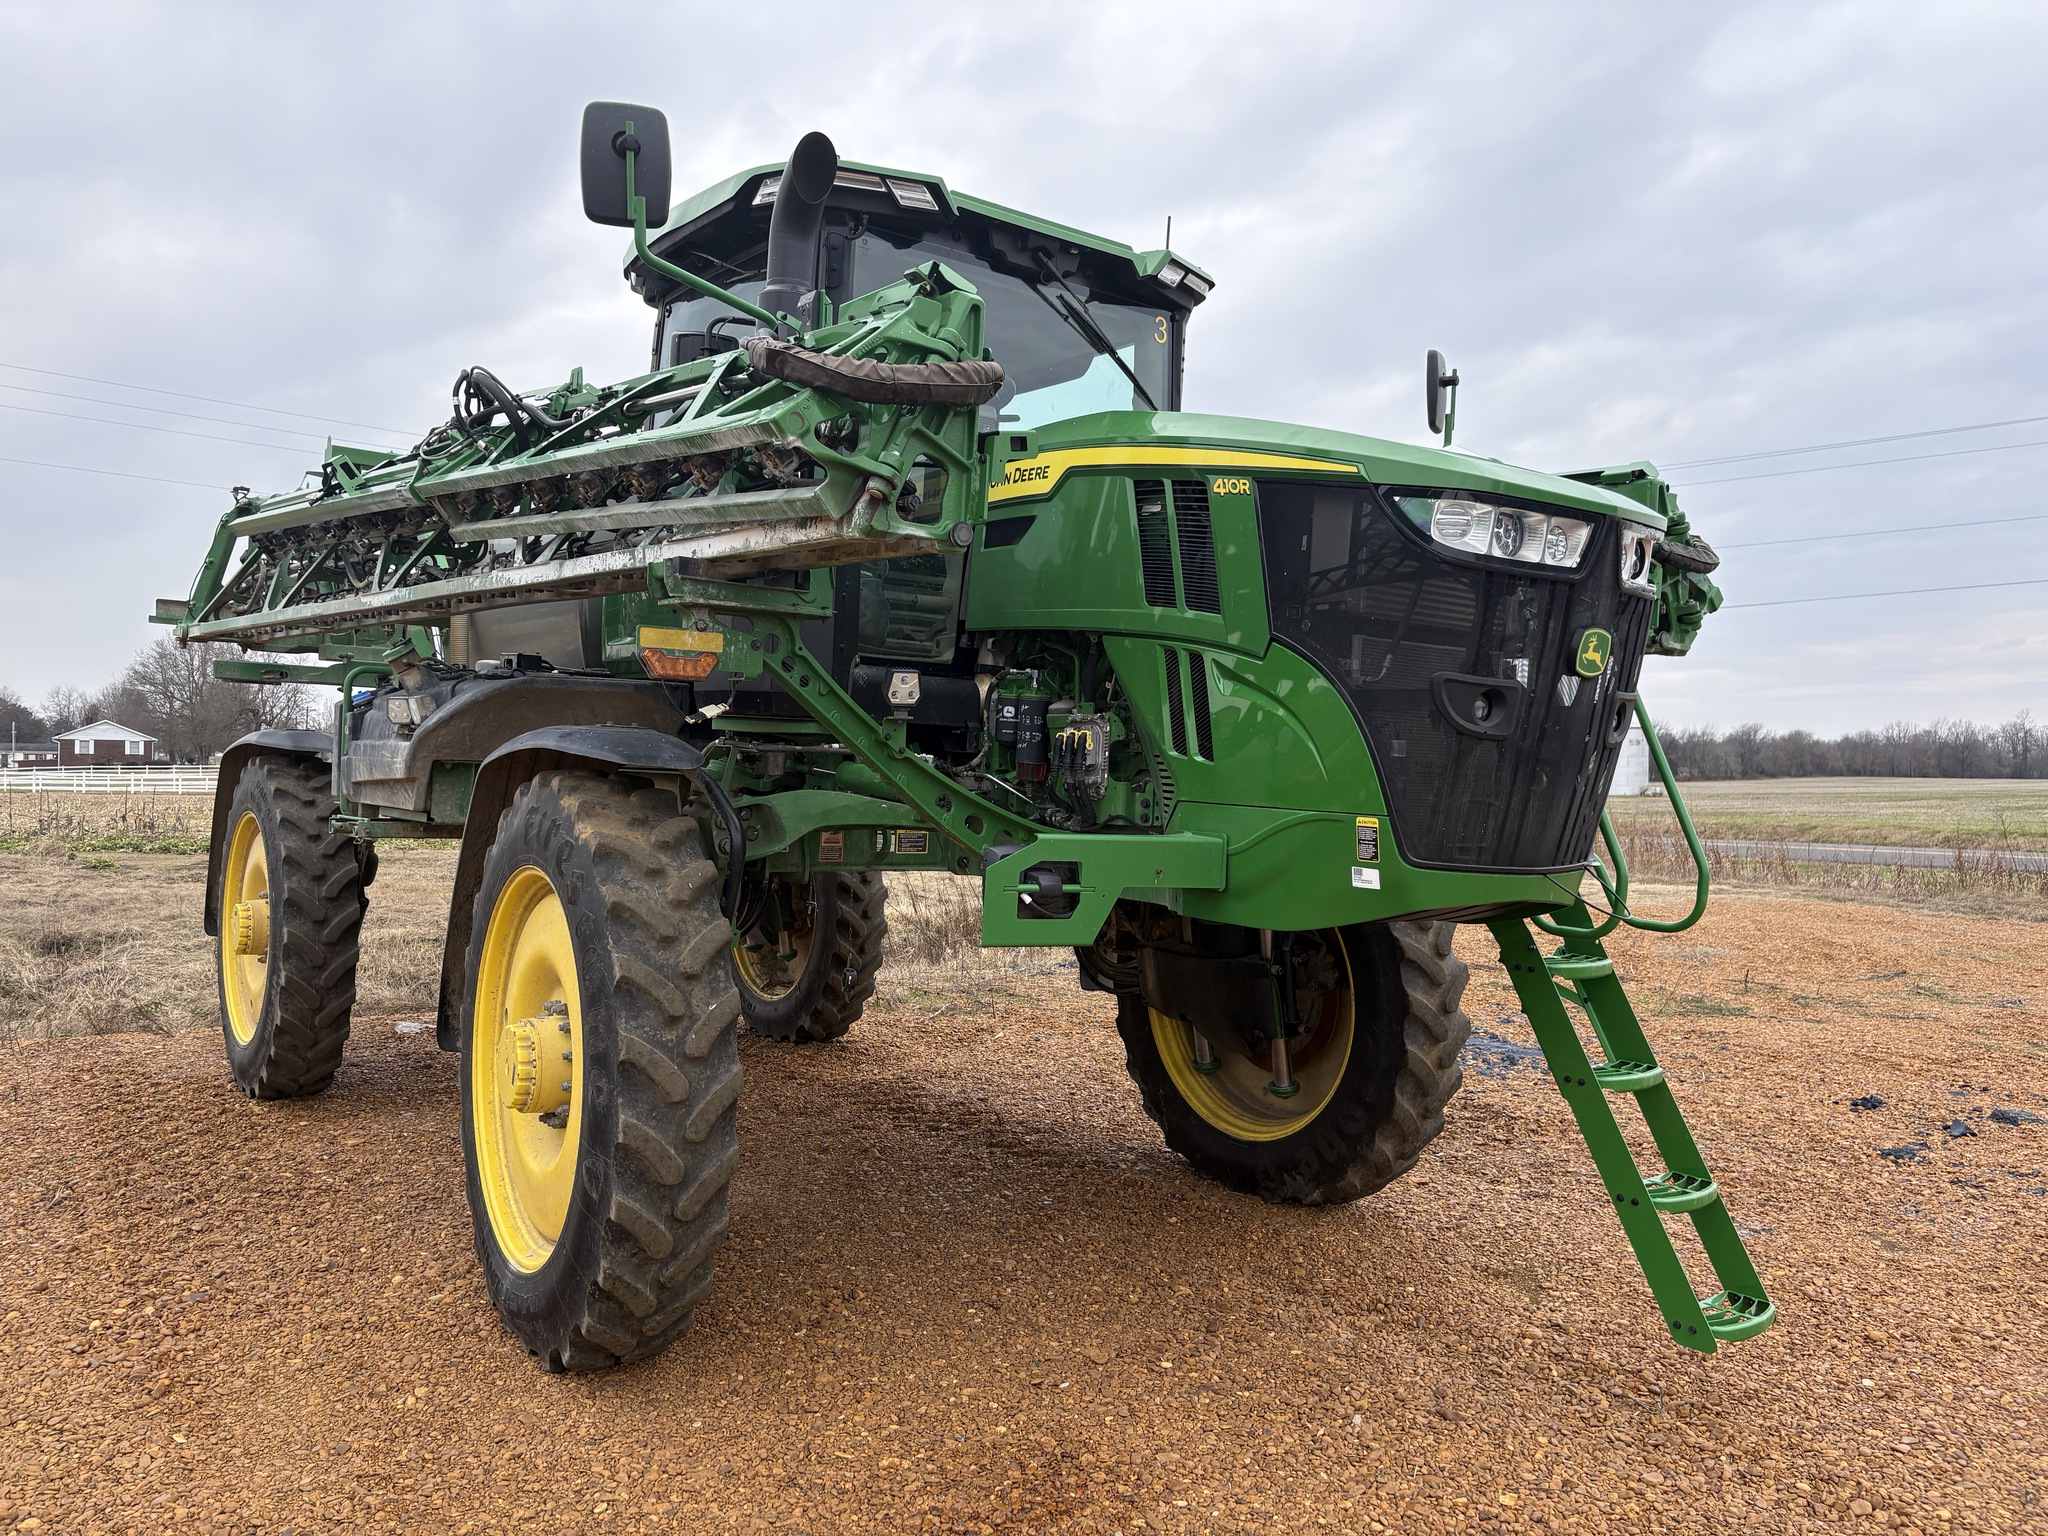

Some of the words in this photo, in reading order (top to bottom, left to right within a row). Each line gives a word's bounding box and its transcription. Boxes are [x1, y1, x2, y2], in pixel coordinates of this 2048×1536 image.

[1154, 315, 1168, 344] 3
[1012, 465, 1051, 485] DEERE
[1213, 478, 1251, 496] 410R
